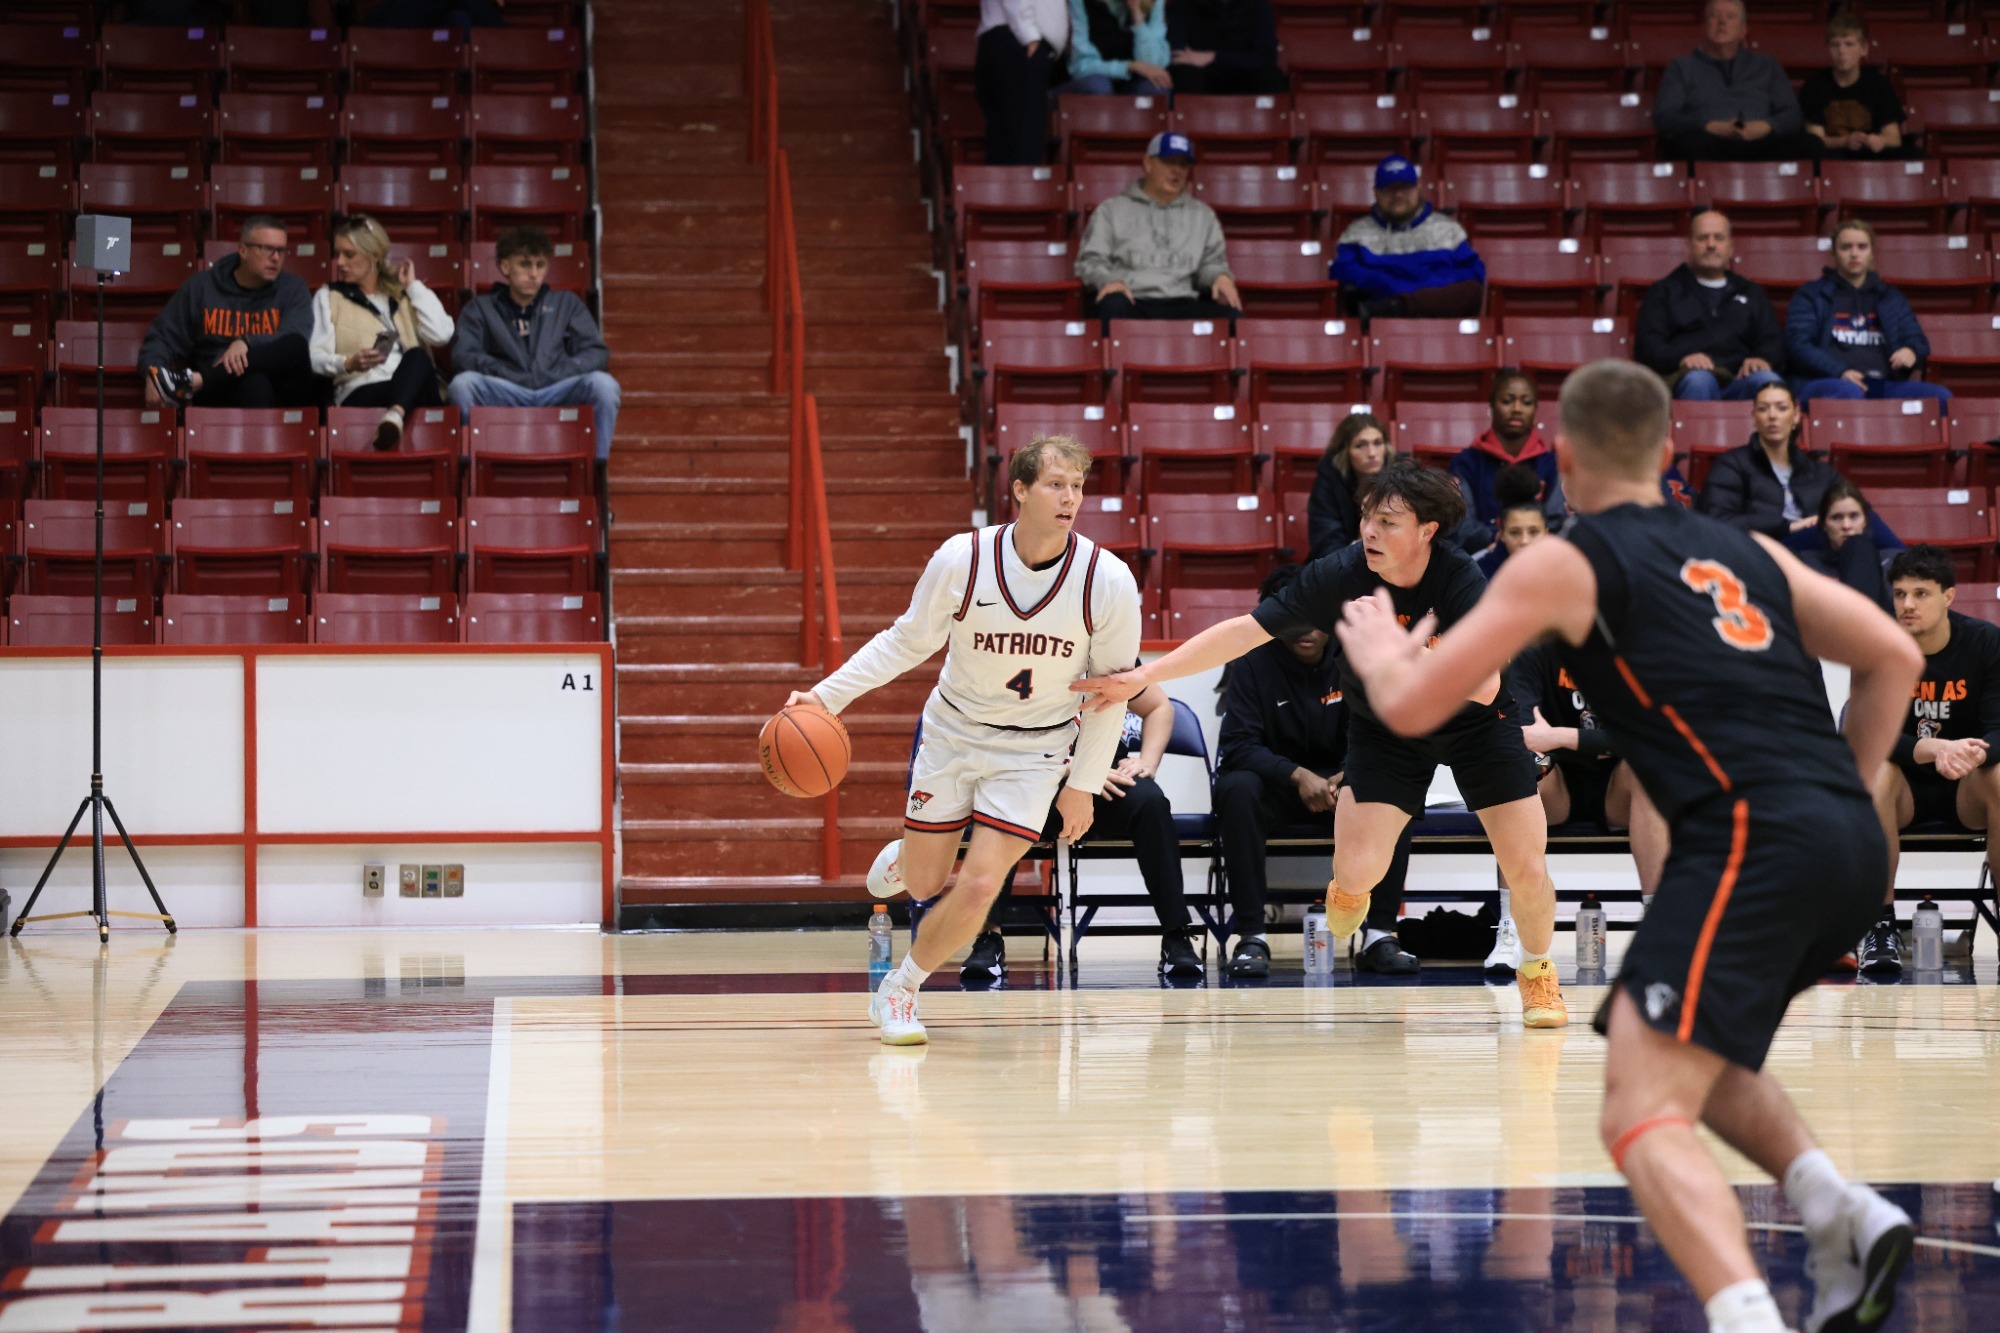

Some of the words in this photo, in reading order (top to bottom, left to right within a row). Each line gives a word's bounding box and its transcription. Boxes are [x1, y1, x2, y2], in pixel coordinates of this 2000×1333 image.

[1680, 558, 1774, 651] 3
[973, 632, 1075, 658] PATRIOTS
[562, 673, 576, 690] A
[583, 674, 593, 690] 1
[1005, 668, 1033, 700] 4
[1942, 679, 1967, 701] AS
[1914, 698, 1950, 719] ONE
